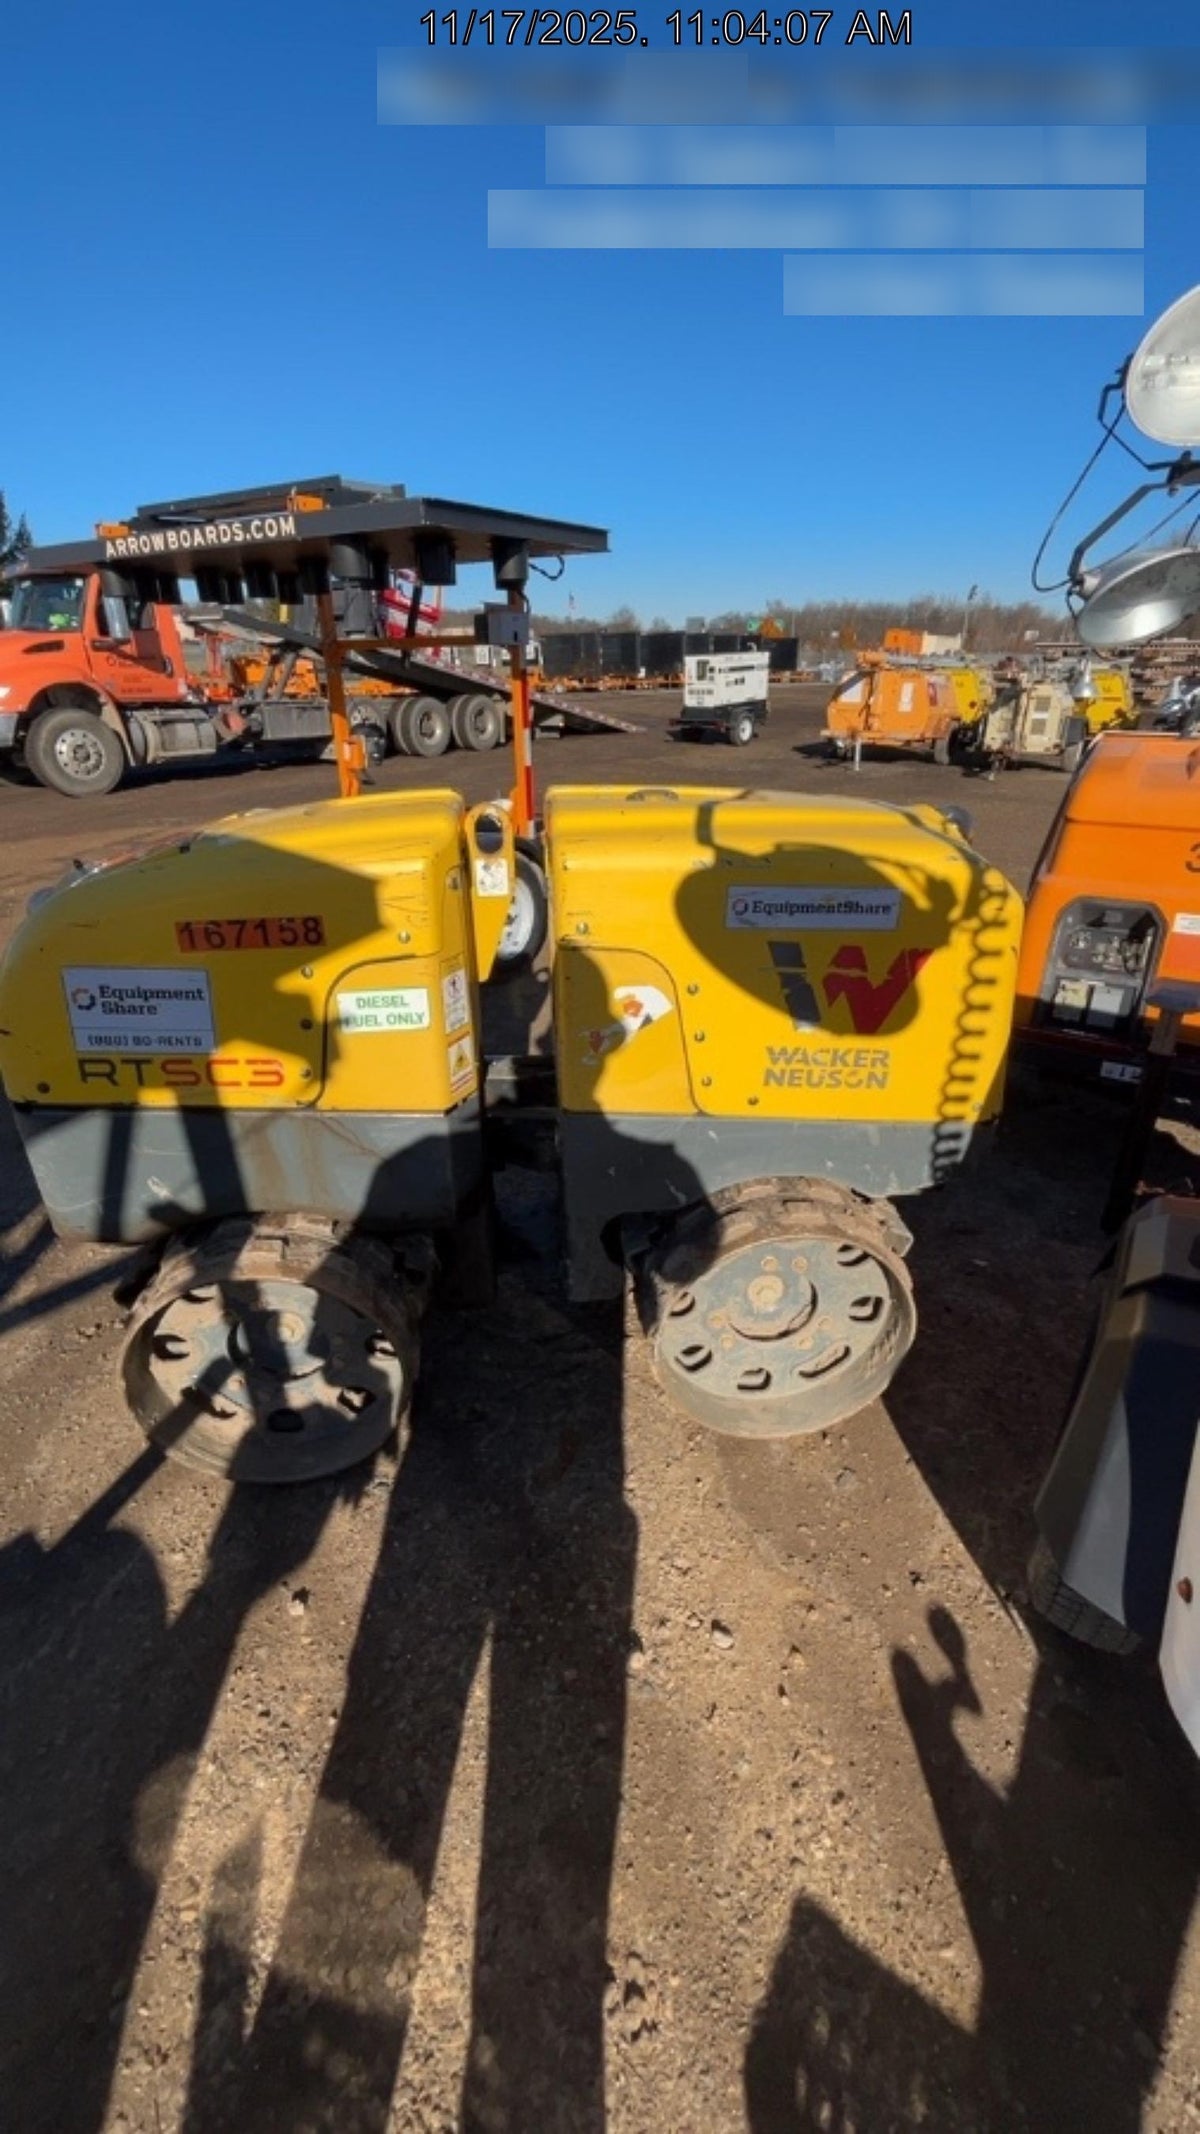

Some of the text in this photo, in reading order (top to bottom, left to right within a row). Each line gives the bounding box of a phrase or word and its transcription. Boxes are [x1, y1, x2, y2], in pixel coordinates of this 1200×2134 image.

[105, 516, 296, 559] ARROWBOARDS.COM
[751, 900, 892, 916] EquipmentShare
[180, 916, 324, 949] 167158
[98, 985, 205, 1002] Equipment
[356, 995, 410, 1009] DIESEL
[101, 1002, 157, 1016] Share
[386, 1011, 425, 1026] ONLY
[766, 1045, 891, 1068] WACKER
[79, 1058, 284, 1087] RTSC3
[764, 1069, 889, 1090] NEUSON
